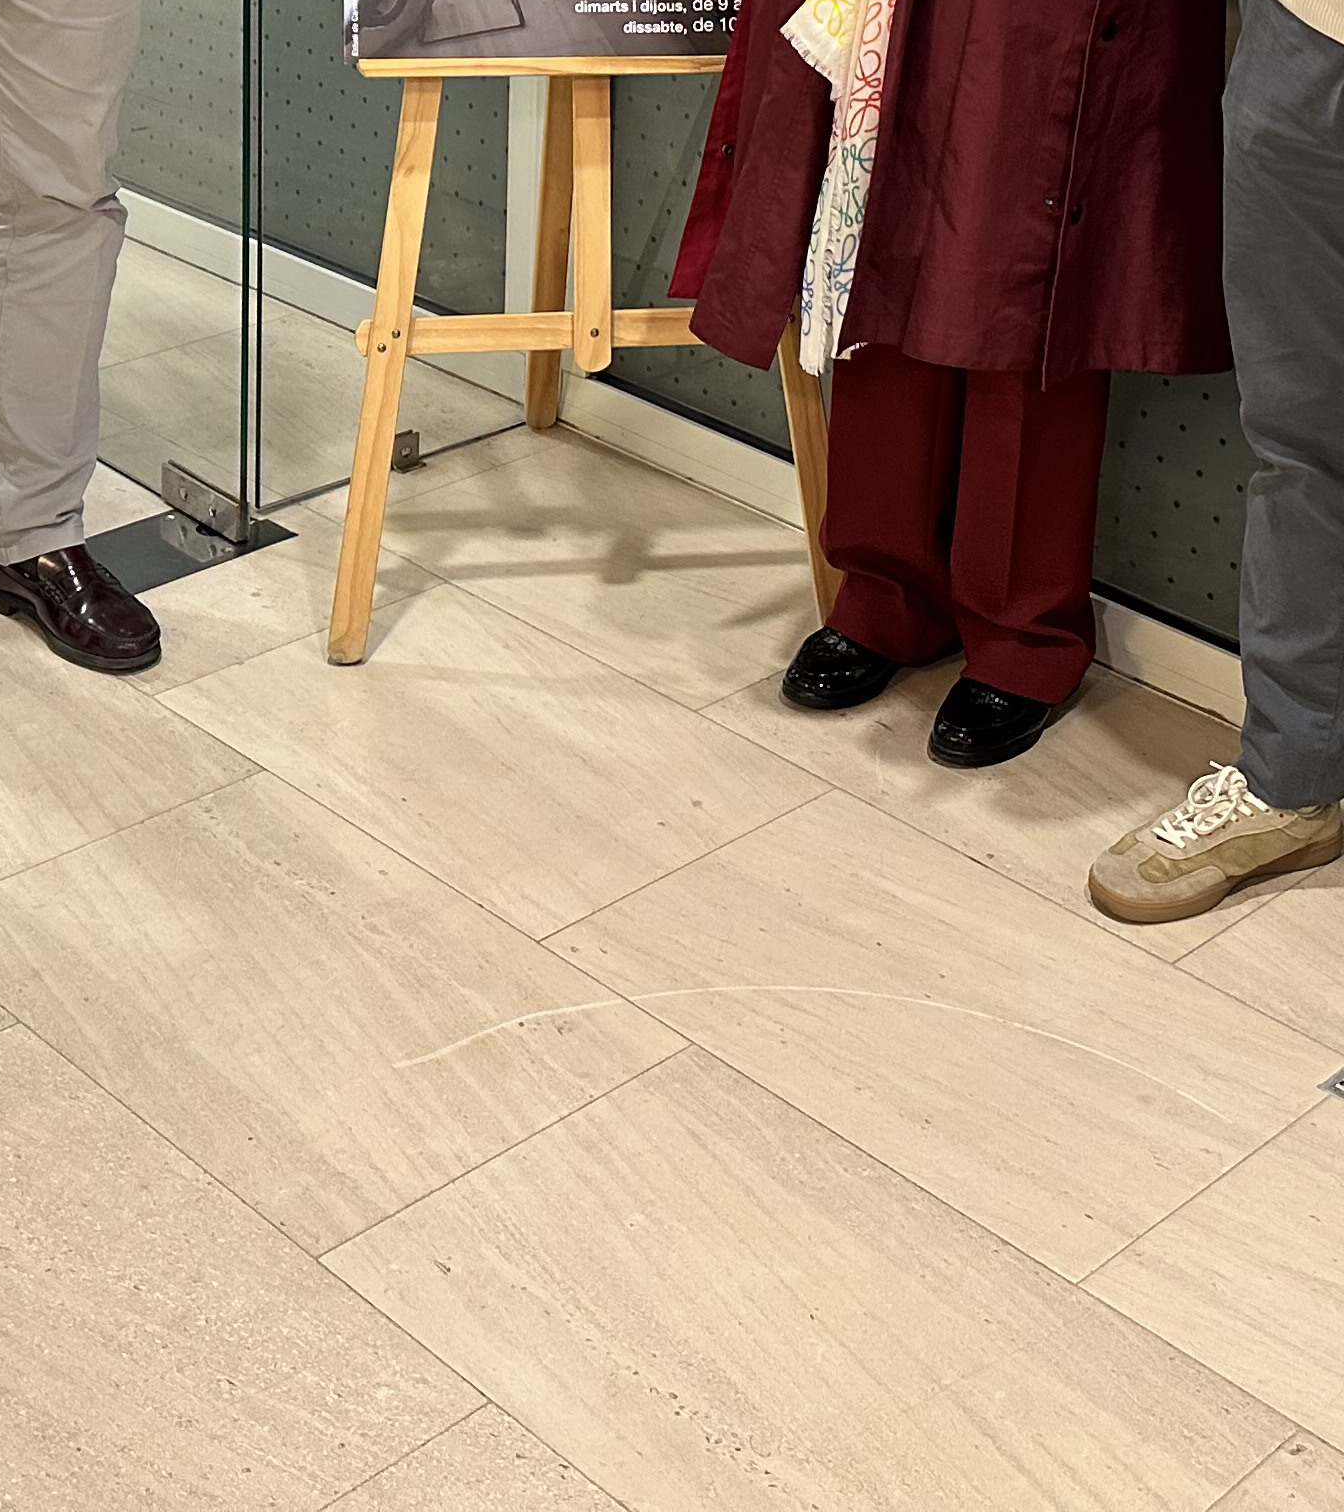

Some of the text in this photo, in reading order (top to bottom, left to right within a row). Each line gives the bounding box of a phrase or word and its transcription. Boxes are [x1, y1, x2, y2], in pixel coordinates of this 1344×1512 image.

[574, 0, 629, 13] dimarts
[640, 0, 687, 15] dijous,
[623, 21, 688, 35] dissabte,
[692, 17, 714, 32] de
